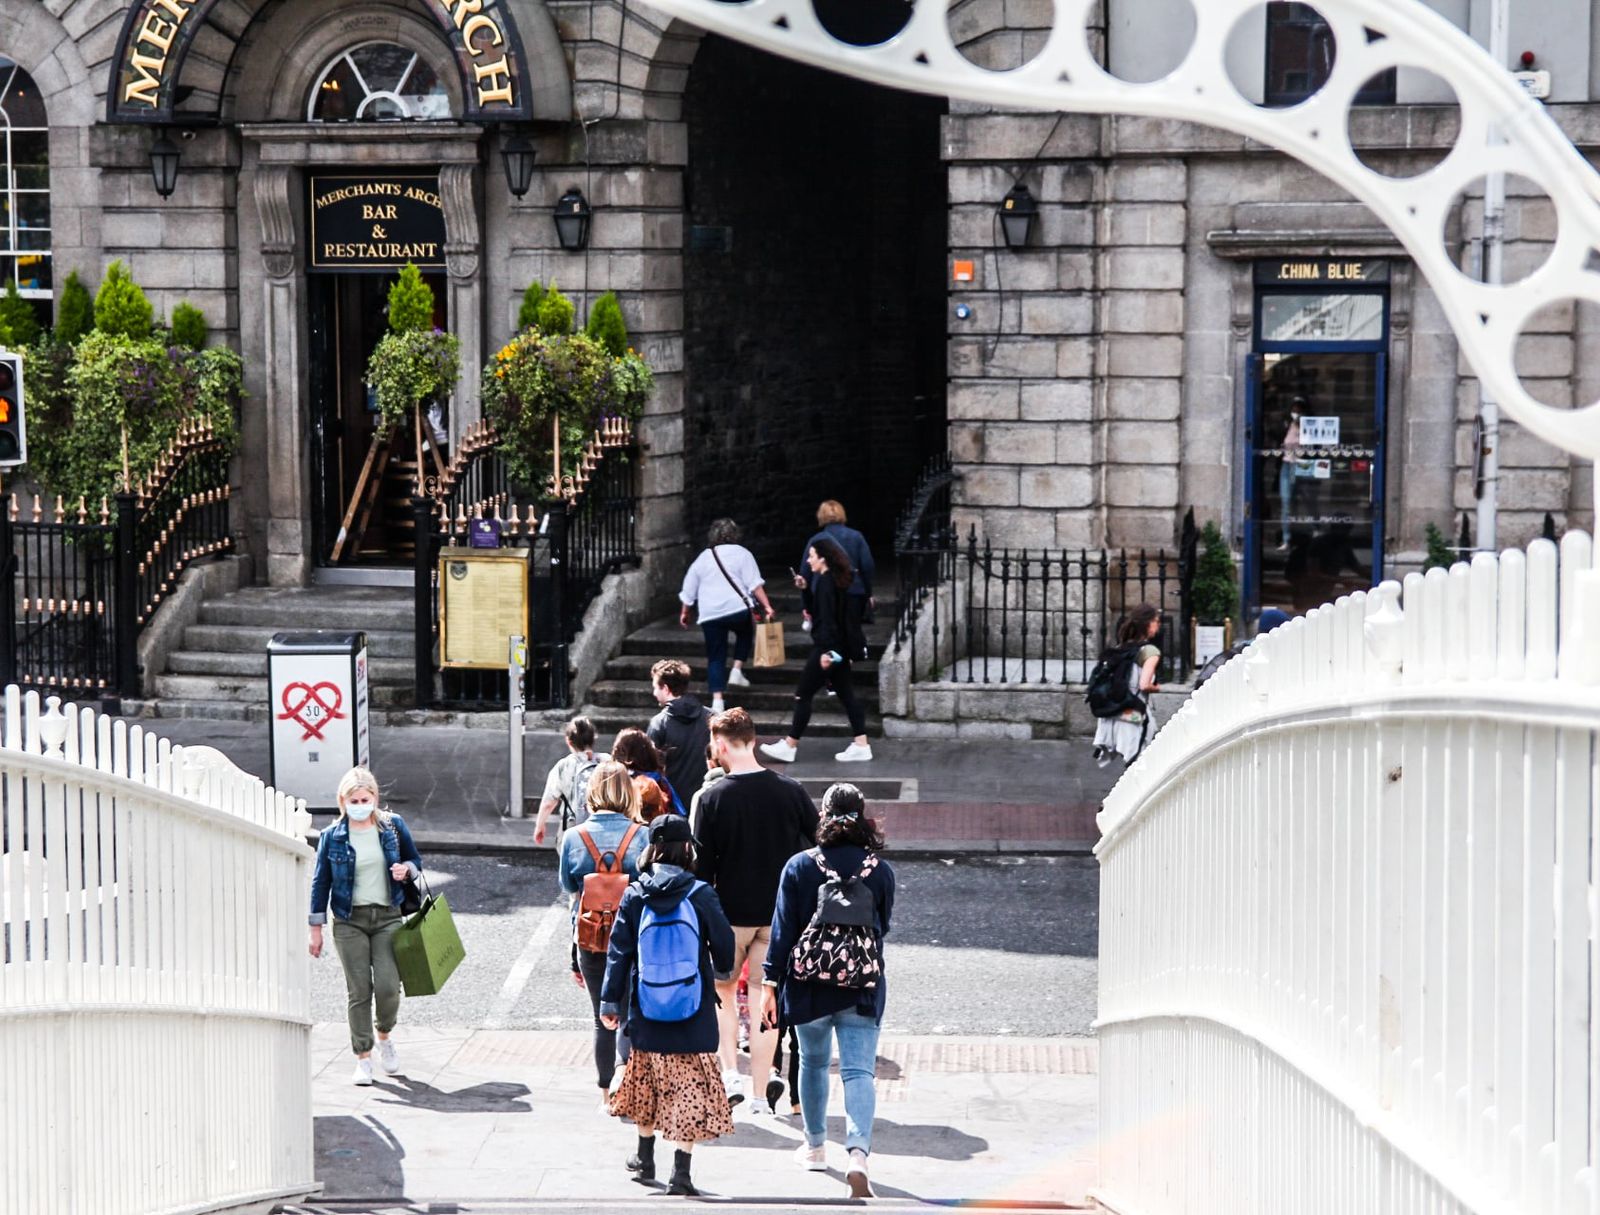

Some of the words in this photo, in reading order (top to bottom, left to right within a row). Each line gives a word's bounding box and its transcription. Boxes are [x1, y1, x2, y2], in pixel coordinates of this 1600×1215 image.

[440, 0, 513, 108] RCH
[316, 183, 401, 209] MERCHANTS
[404, 186, 441, 208] ARCH
[362, 204, 398, 219] BAR
[372, 224, 387, 239] &
[324, 243, 437, 258] RESTAURANT
[307, 705, 320, 716] 30
